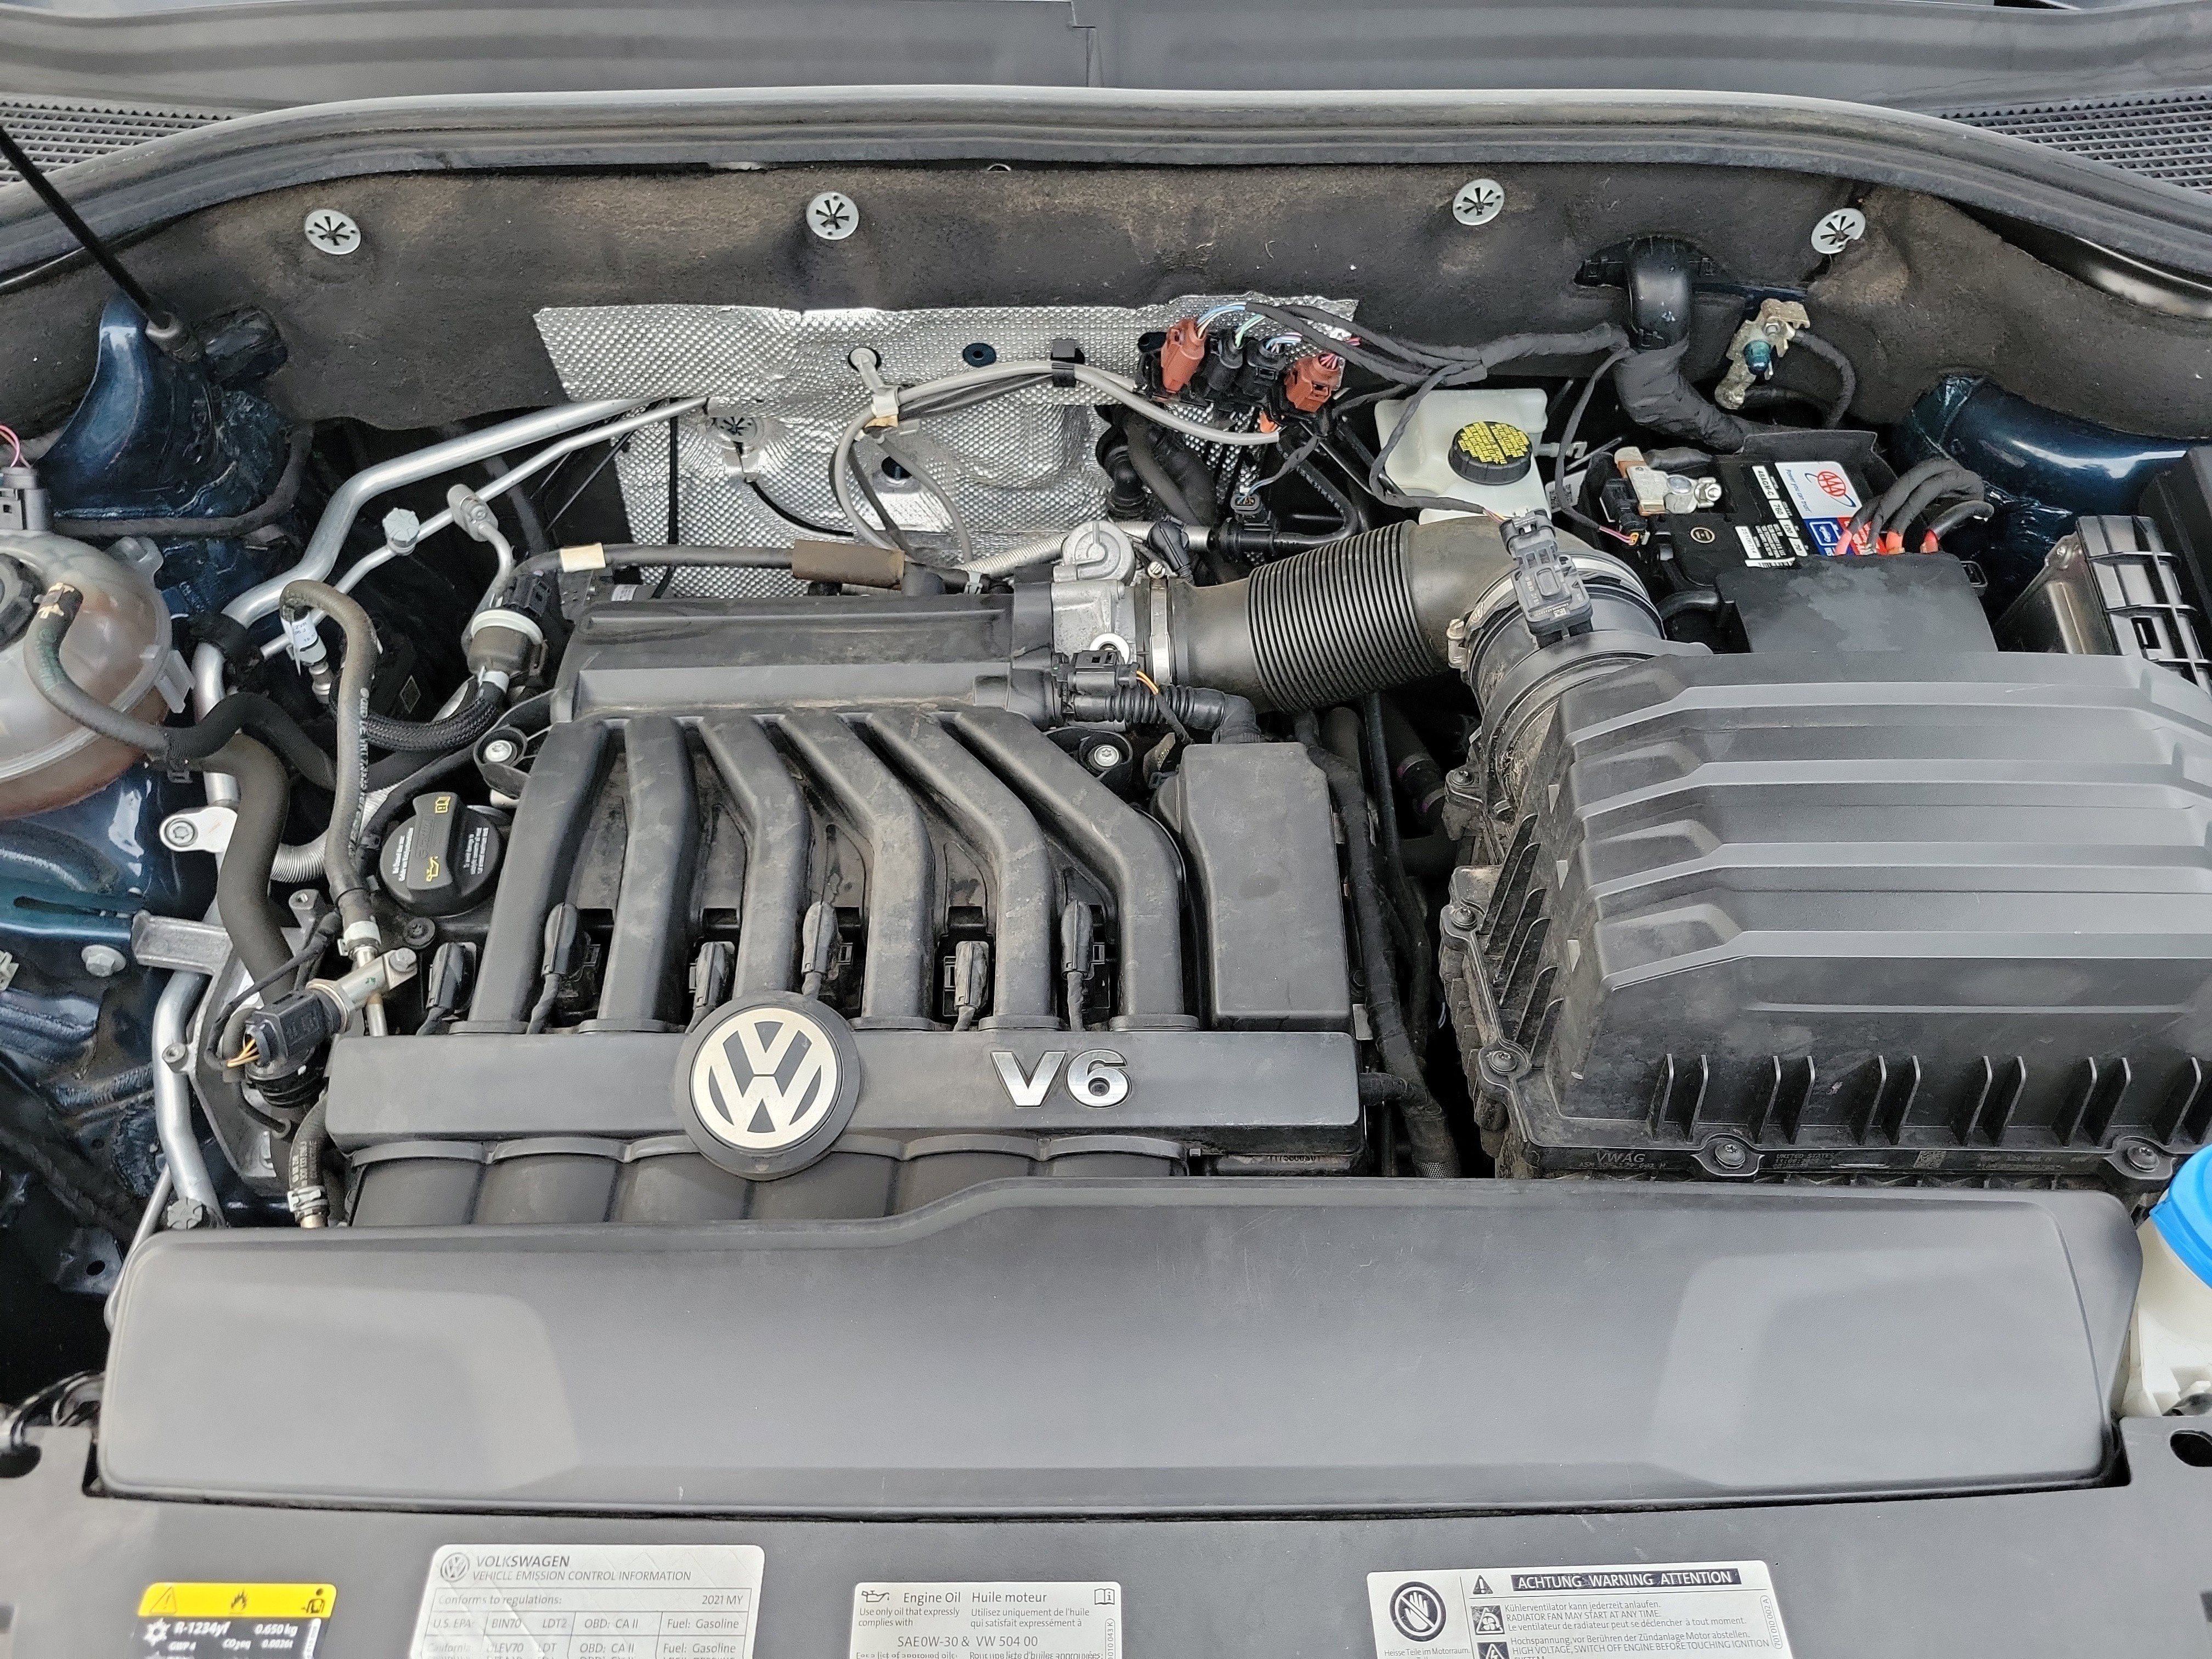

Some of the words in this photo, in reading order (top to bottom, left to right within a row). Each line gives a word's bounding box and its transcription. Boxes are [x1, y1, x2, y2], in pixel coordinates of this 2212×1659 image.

[1819, 472, 1845, 496] AAA
[1773, 505, 1784, 514] 760
[1783, 524, 1793, 533] 120
[991, 1049, 1131, 1108] V6
[477, 1556, 570, 1567] VOLKSWAGEN
[473, 1571, 512, 1581] VEHICLE
[516, 1571, 565, 1581] EMISSION
[568, 1571, 616, 1581] CONTROL
[619, 1571, 691, 1581] INFORMATION
[1519, 1575, 1582, 1589] ACHTUNG
[1588, 1573, 1654, 1587] WARNING
[1661, 1571, 1732, 1585] ATTENTION
[438, 1595, 487, 1605] Conforms
[489, 1596, 500, 1605] to
[503, 1595, 562, 1607] regulations:
[702, 1595, 724, 1605] 2021
[726, 1595, 743, 1605] MY
[904, 1592, 942, 1606] Engine
[945, 1592, 961, 1602] Oil
[972, 1592, 1002, 1602] Huile
[1005, 1593, 1047, 1602] moteur
[1505, 1603, 1566, 1612] Kühlerventilator
[1589, 1601, 1622, 1611] jederzeit
[1624, 1600, 1661, 1609] anlaufen.
[876, 1607, 893, 1617] only
[894, 1607, 904, 1616] oil
[906, 1607, 922, 1616] that
[924, 1607, 960, 1617] expressly
[971, 1608, 1000, 1616] Utilisez
[1003, 1609, 1052, 1618] uniquement
[1053, 1608, 1064, 1616] de
[1065, 1608, 1090, 1616] l'huile
[1506, 1613, 1546, 1622] RADIATOR
[1584, 1611, 1607, 1619] START
[433, 1618, 451, 1628] U.S.
[492, 1618, 522, 1628] BIN70
[543, 1618, 567, 1628] LDT2
[584, 1618, 610, 1628] OBD:
[616, 1618, 630, 1628] CA
[667, 1618, 691, 1628] Fuel:
[696, 1618, 739, 1628] Gasoline
[859, 1618, 893, 1628] complies
[895, 1618, 913, 1626] with
[970, 1620, 983, 1629] qui
[985, 1619, 1017, 1627] satisfait
[1019, 1619, 1075, 1629] expressément
[1518, 1622, 1560, 1631] ventilateur
[1574, 1621, 1609, 1629] radiateur
[1611, 1621, 1628, 1630] peut
[1641, 1618, 1682, 1628] déclencher
[173, 1621, 231, 1638] R-1234yf
[284, 1624, 298, 1637] kg
[961, 1636, 970, 1647] &
[976, 1636, 996, 1646] VW
[999, 1636, 1020, 1646] 504
[1024, 1636, 1038, 1646] 00
[1511, 1636, 1572, 1646] Hochspannung,
[1587, 1634, 1623, 1643] Berühren
[1639, 1633, 1684, 1643] Zündanlage
[1686, 1632, 1711, 1640] Motor
[1712, 1630, 1750, 1639] abstellen.
[580, 1643, 606, 1653] OBD:
[611, 1643, 625, 1653] CA
[663, 1643, 686, 1653] Fuel:
[692, 1643, 736, 1653] Gasoline
[1432, 1646, 1470, 1655] Motorraum.
[1513, 1646, 1534, 1655] HIGH
[1536, 1645, 1573, 1654] VOLTAGE,
[1574, 1644, 1605, 1652] SWITCH
[1656, 1642, 1685, 1650] BEFORE
[1687, 1640, 1731, 1649] TOUCHING
[1733, 1639, 1769, 1647] IGNITION
